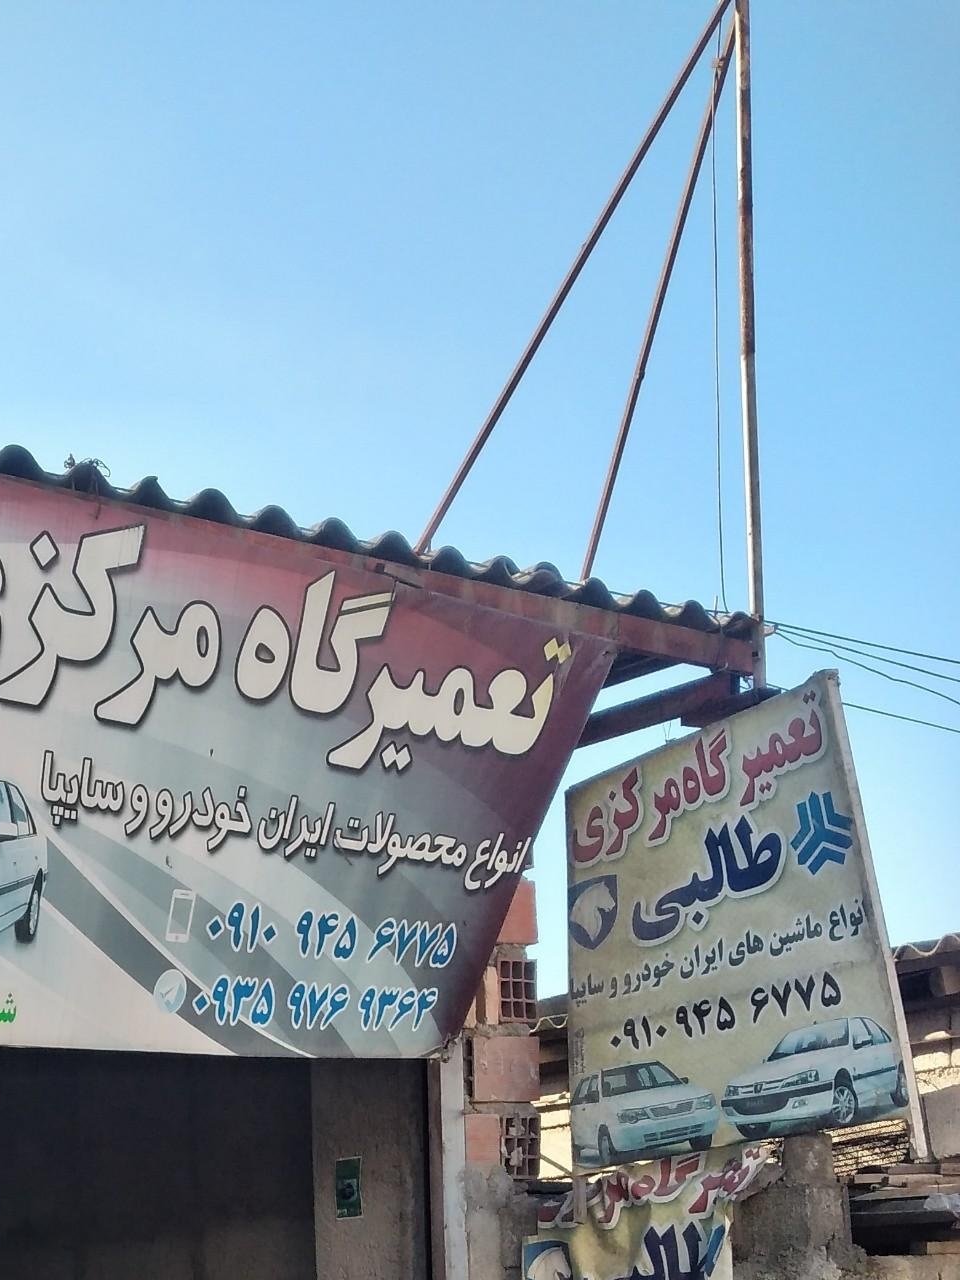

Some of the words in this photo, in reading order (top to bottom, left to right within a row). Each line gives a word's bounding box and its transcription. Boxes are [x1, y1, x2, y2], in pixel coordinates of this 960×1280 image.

[234, 570, 571, 774] تعمیرگاه
[40, 751, 125, 826] سایپا
[125, 782, 144, 836] و
[150, 785, 252, 851] خودرو
[257, 796, 336, 861] ایران
[333, 814, 466, 876] محصولات
[464, 833, 532, 890] انواع
[633, 815, 782, 940] طالبی
[205, 901, 279, 953] ۰۹۱۰
[296, 908, 358, 961] ۹۴۵
[366, 917, 457, 969] ۶۷۷۵
[680, 938, 723, 978] ایران
[729, 930, 764, 966] های
[770, 914, 822, 956] ماشین
[191, 974, 275, 1027] ۰۹۳۵
[287, 981, 351, 1031] ۹۷۶
[357, 986, 439, 1032] ۹۳۶۴
[570, 974, 604, 1007] سایپا
[609, 976, 618, 998] و
[622, 953, 674, 995] خودرو
[610, 1015, 668, 1050] ۰۹۱۰
[676, 996, 735, 1038] ۹۴۵
[750, 971, 842, 1024] ۶۷۷۵
